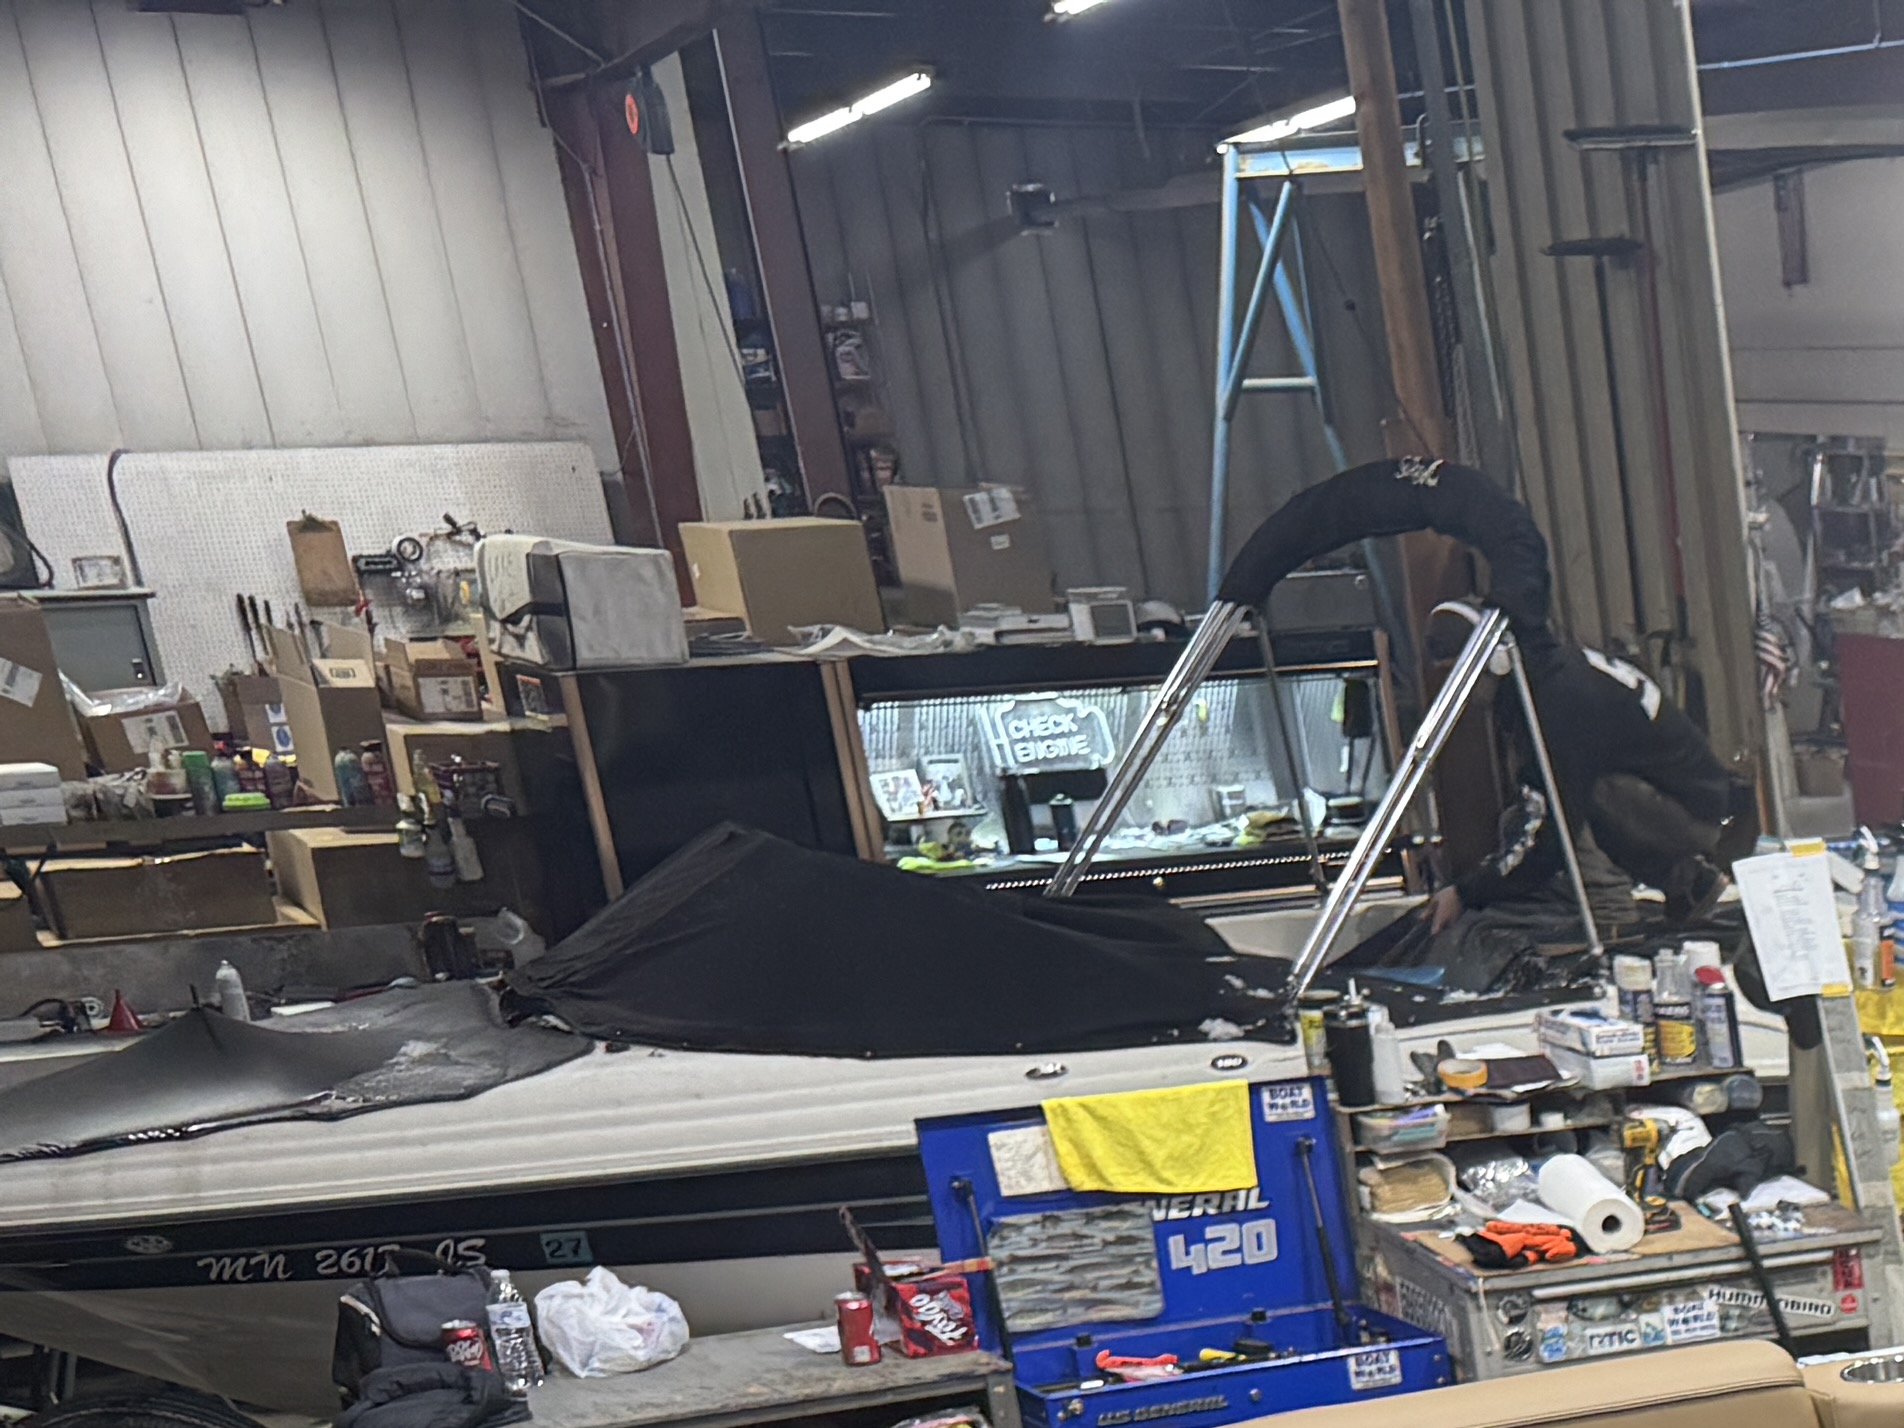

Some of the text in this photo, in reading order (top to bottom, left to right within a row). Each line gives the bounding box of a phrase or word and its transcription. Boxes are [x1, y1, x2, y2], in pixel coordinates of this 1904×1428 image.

[1008, 712, 1079, 739] CHECK
[1014, 734, 1092, 763] ENGINE
[1150, 1187, 1270, 1221] NERAL
[545, 1238, 582, 1258] 27
[1168, 1218, 1279, 1275] 420
[197, 1250, 293, 1281] MN
